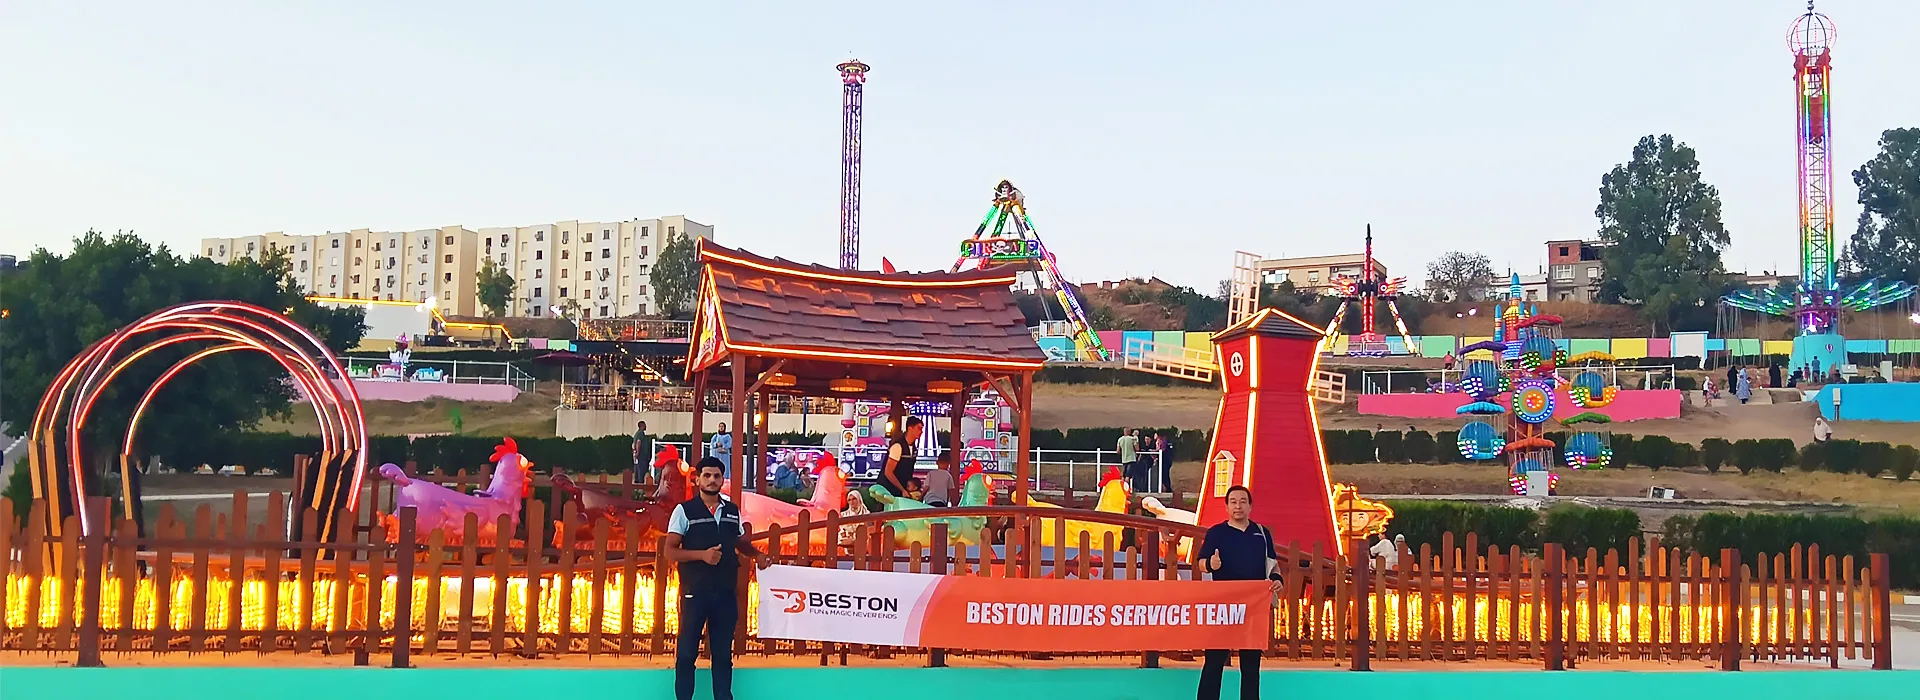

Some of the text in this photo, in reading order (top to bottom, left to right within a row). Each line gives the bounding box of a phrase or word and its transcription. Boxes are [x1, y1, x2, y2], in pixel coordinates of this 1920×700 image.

[963, 241, 1039, 257] PIRATE
[809, 592, 898, 617] BESTON
[966, 602, 1247, 626] BESTON RIDES SERVICE TEAM
[852, 611, 877, 619] NEVER
